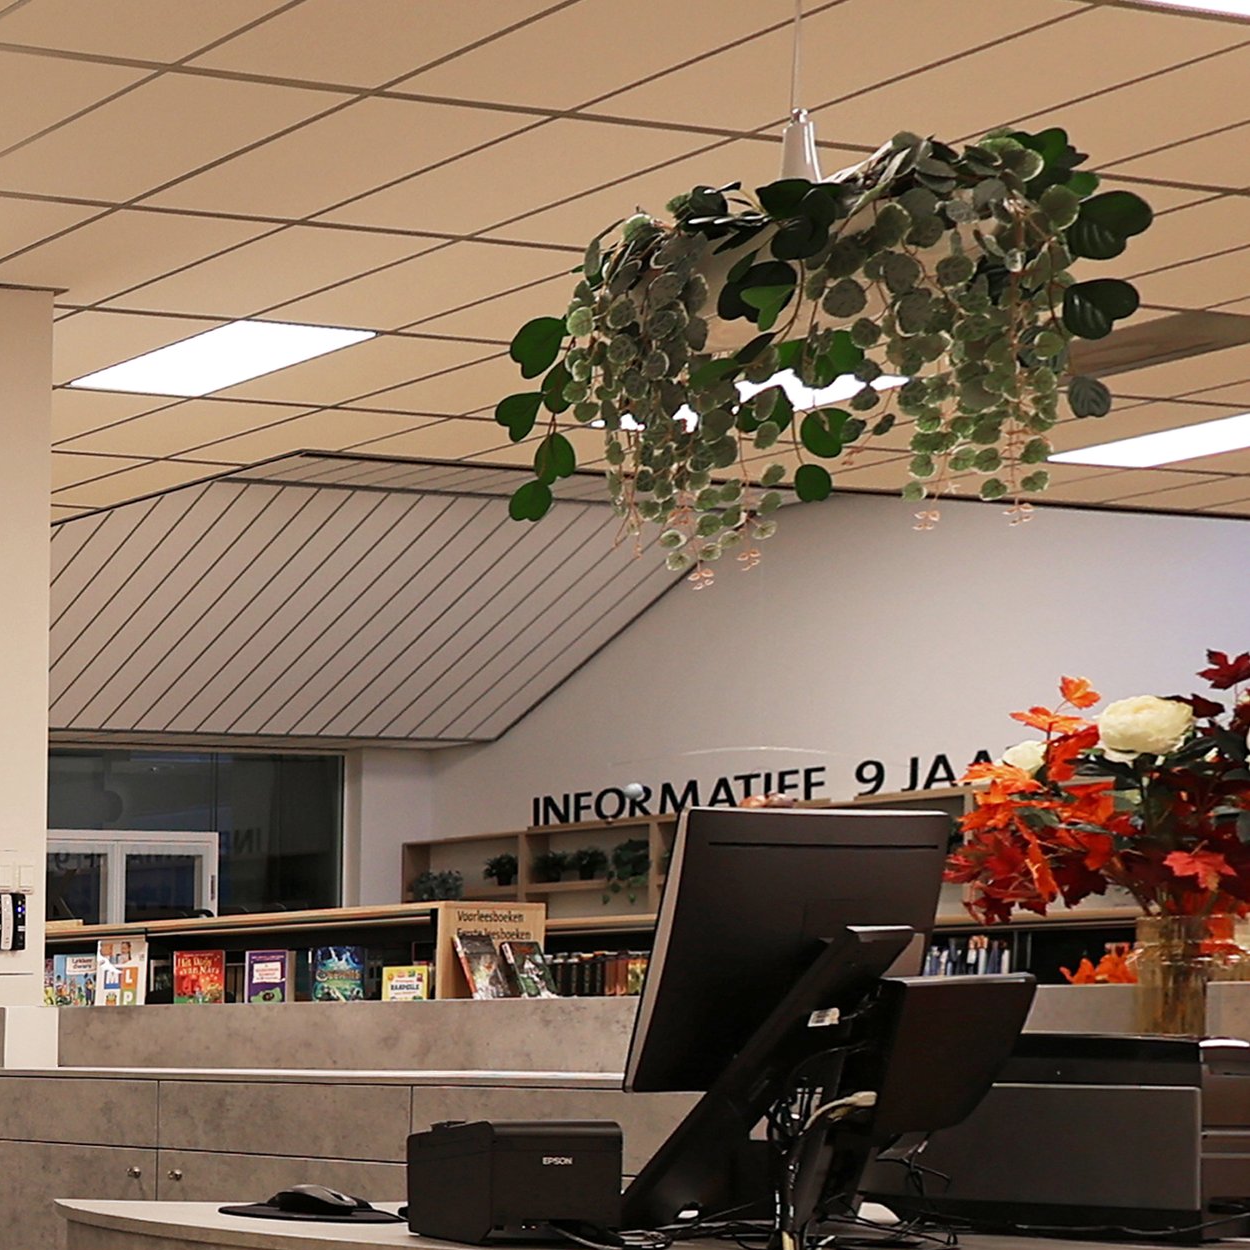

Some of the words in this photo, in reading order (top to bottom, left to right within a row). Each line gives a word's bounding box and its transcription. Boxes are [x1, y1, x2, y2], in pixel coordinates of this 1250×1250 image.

[855, 760, 885, 796] 9
[457, 910, 524, 922] Voorleesboeken
[542, 1156, 573, 1165] EPSON
